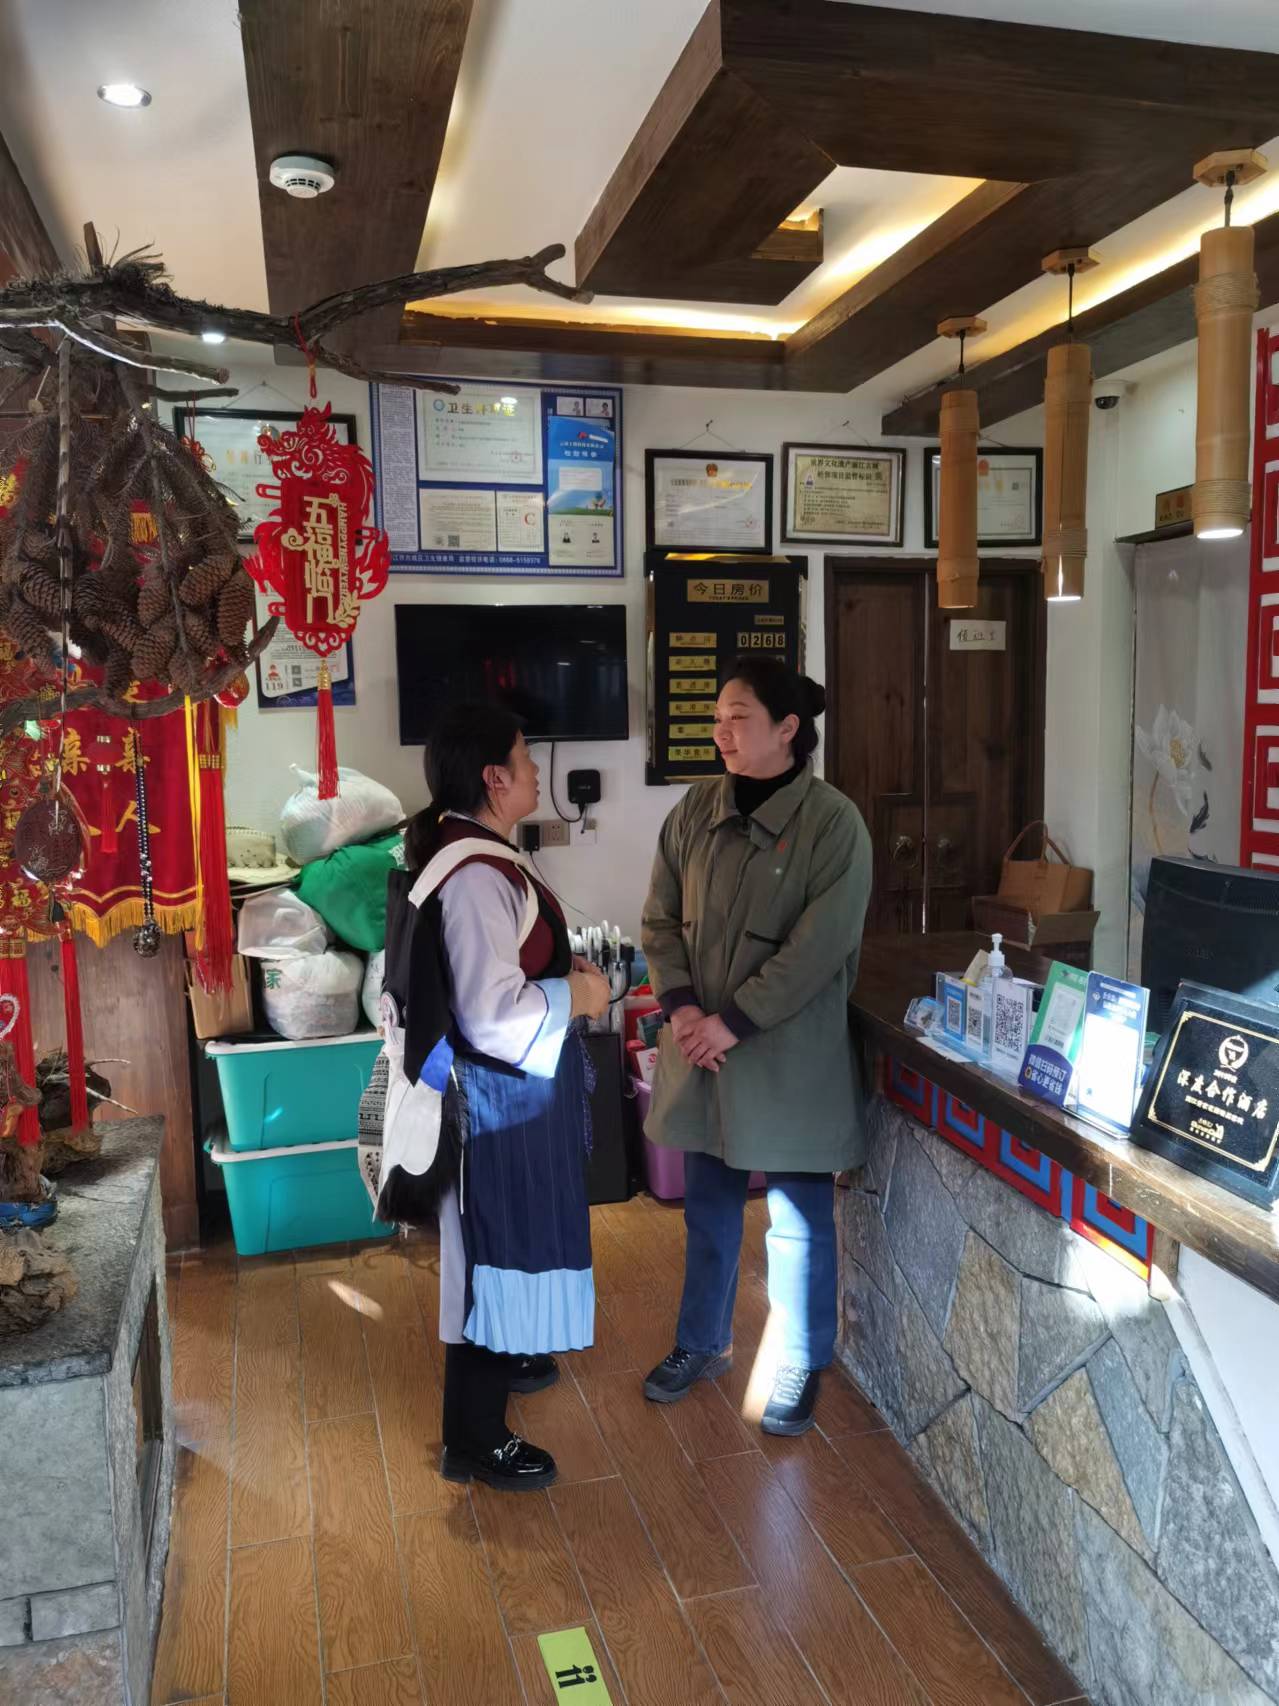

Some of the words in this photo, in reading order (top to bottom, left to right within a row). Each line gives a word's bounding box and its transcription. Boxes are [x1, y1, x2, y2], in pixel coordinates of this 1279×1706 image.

[303, 495, 334, 624] 五福临门
[693, 582, 762, 596] 今日房价
[740, 635, 784, 647] 0268
[264, 968, 282, 990] 家
